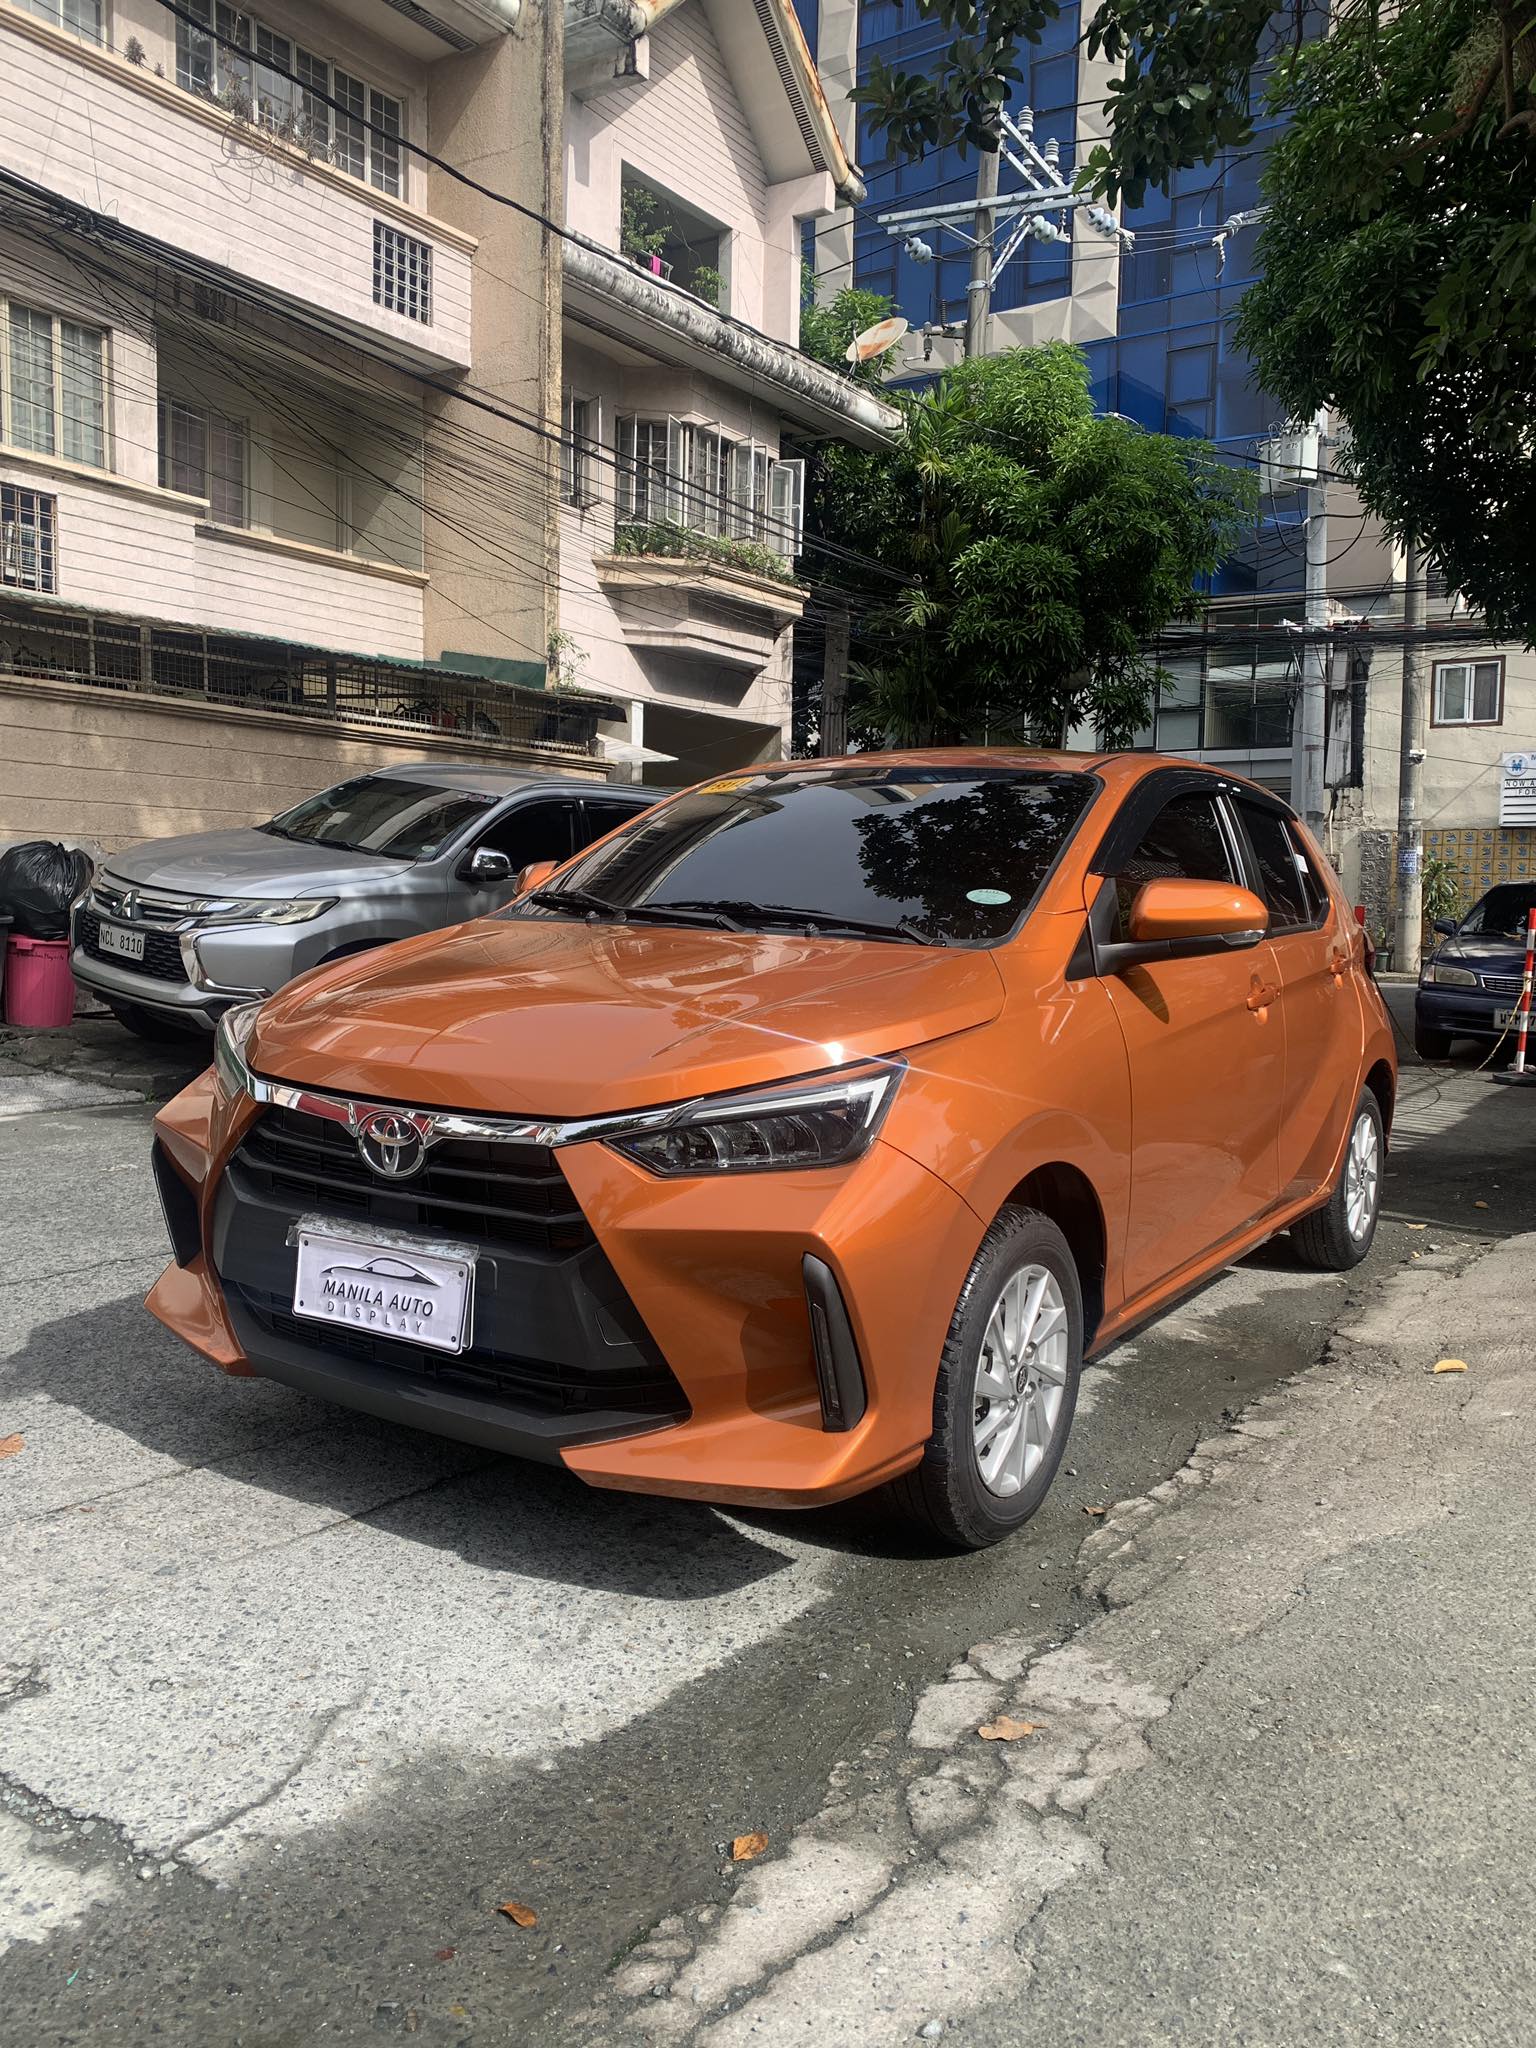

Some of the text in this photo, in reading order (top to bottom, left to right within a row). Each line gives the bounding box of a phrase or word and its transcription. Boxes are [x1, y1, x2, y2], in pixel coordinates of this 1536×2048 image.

[100, 929, 143, 954] NCL 8110
[323, 1279, 434, 1317] MANILA AUTO
[327, 1300, 423, 1334] DISPLAY
